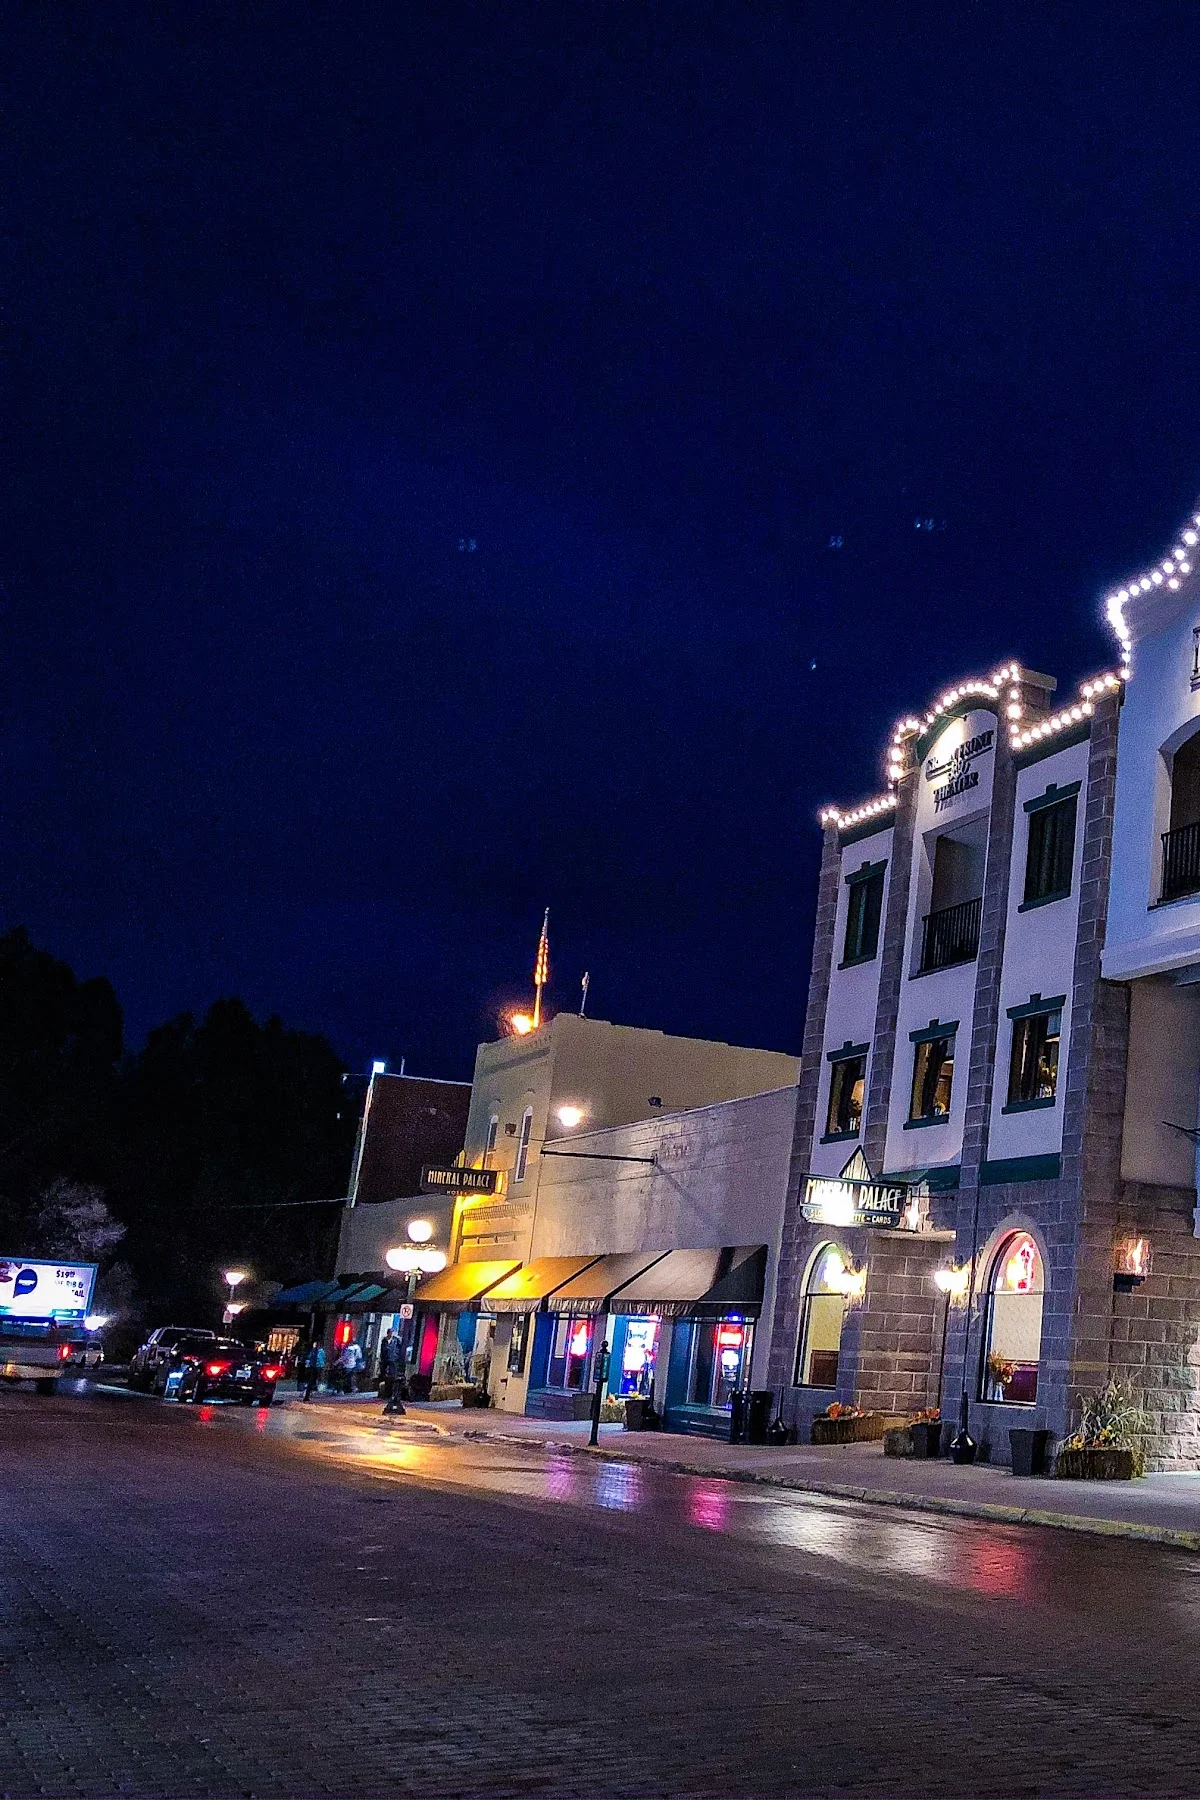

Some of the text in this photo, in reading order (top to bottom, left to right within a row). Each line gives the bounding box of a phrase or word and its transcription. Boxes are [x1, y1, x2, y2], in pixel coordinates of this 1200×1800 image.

[427, 1169, 491, 1188] MINERAL PALACE
[857, 1185, 902, 1213] PALACE
[871, 1214, 892, 1225] CARDS
